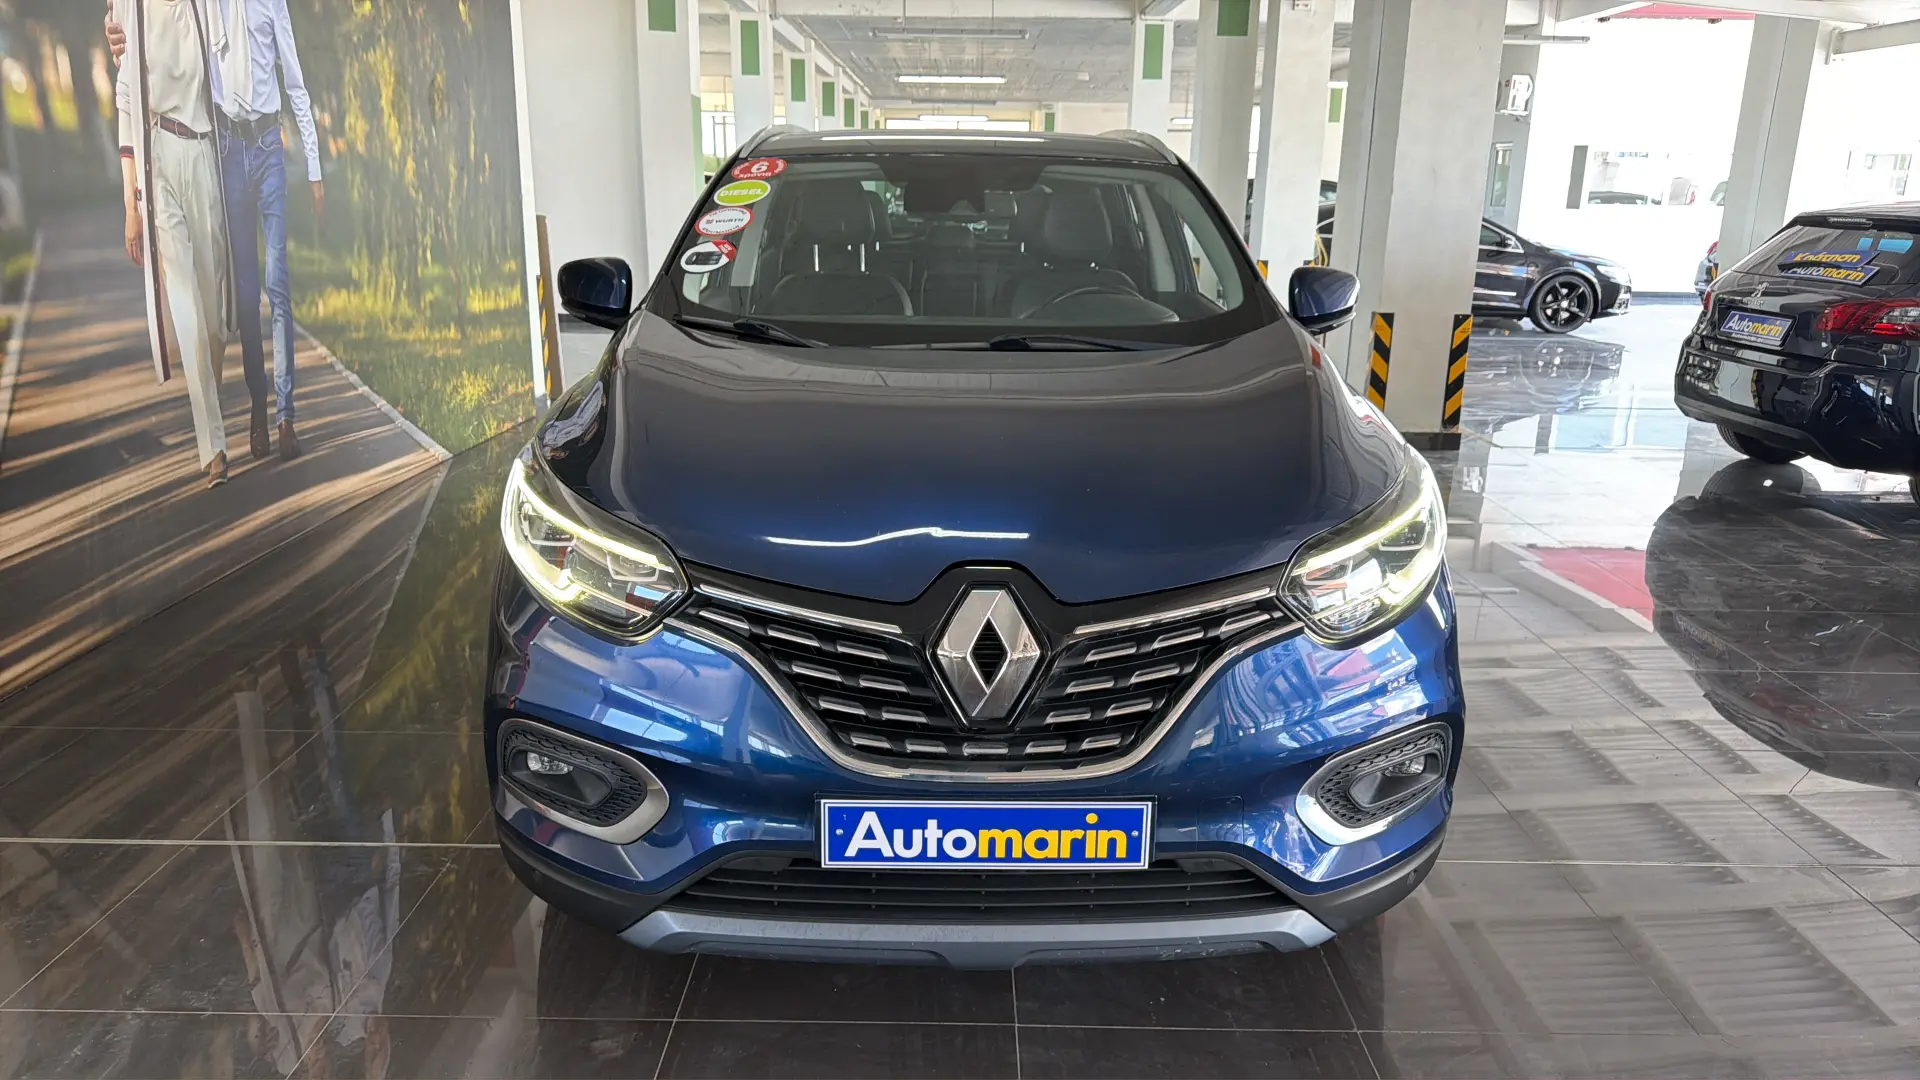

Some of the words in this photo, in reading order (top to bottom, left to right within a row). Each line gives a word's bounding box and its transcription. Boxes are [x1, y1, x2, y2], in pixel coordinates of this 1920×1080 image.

[751, 161, 770, 173] 6
[1726, 315, 1782, 336] Automarin
[844, 811, 1128, 859] Automarin
